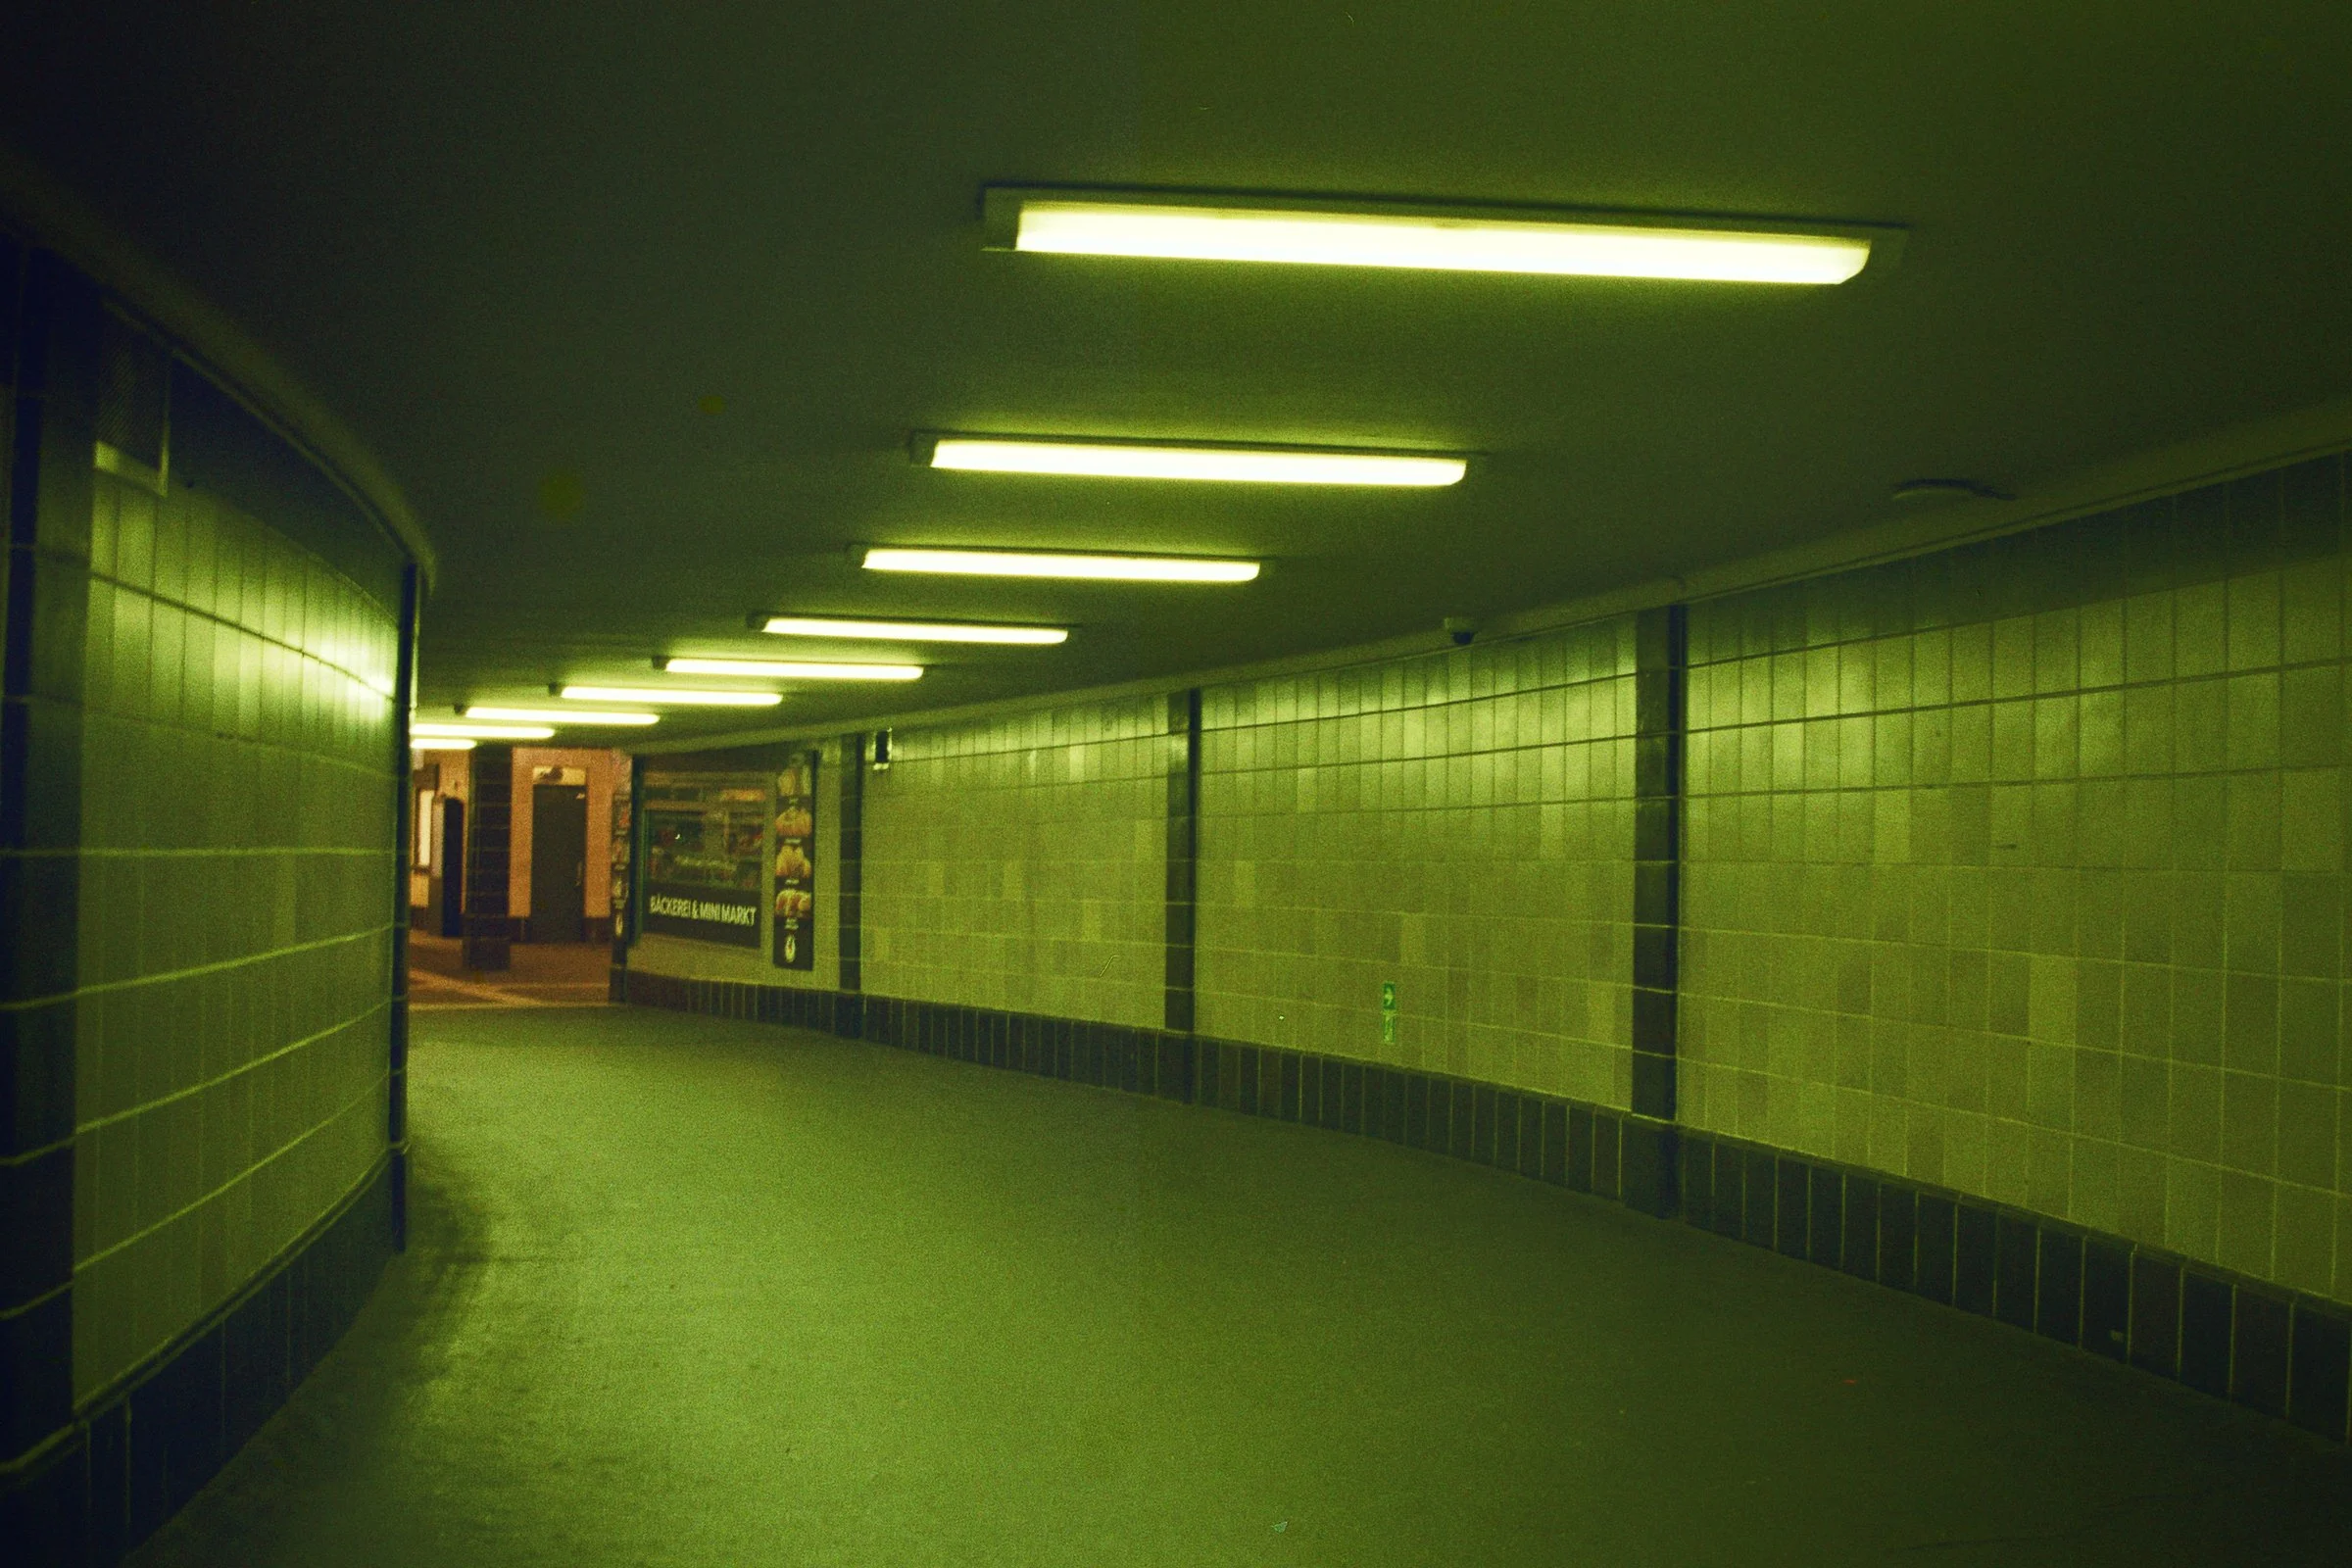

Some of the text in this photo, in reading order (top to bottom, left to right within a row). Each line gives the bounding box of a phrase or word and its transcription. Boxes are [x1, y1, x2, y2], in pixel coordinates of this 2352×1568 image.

[650, 893, 691, 918] BÄCKEREI
[691, 900, 699, 919] &
[700, 902, 720, 922] MINI
[721, 904, 757, 926] MARKT
